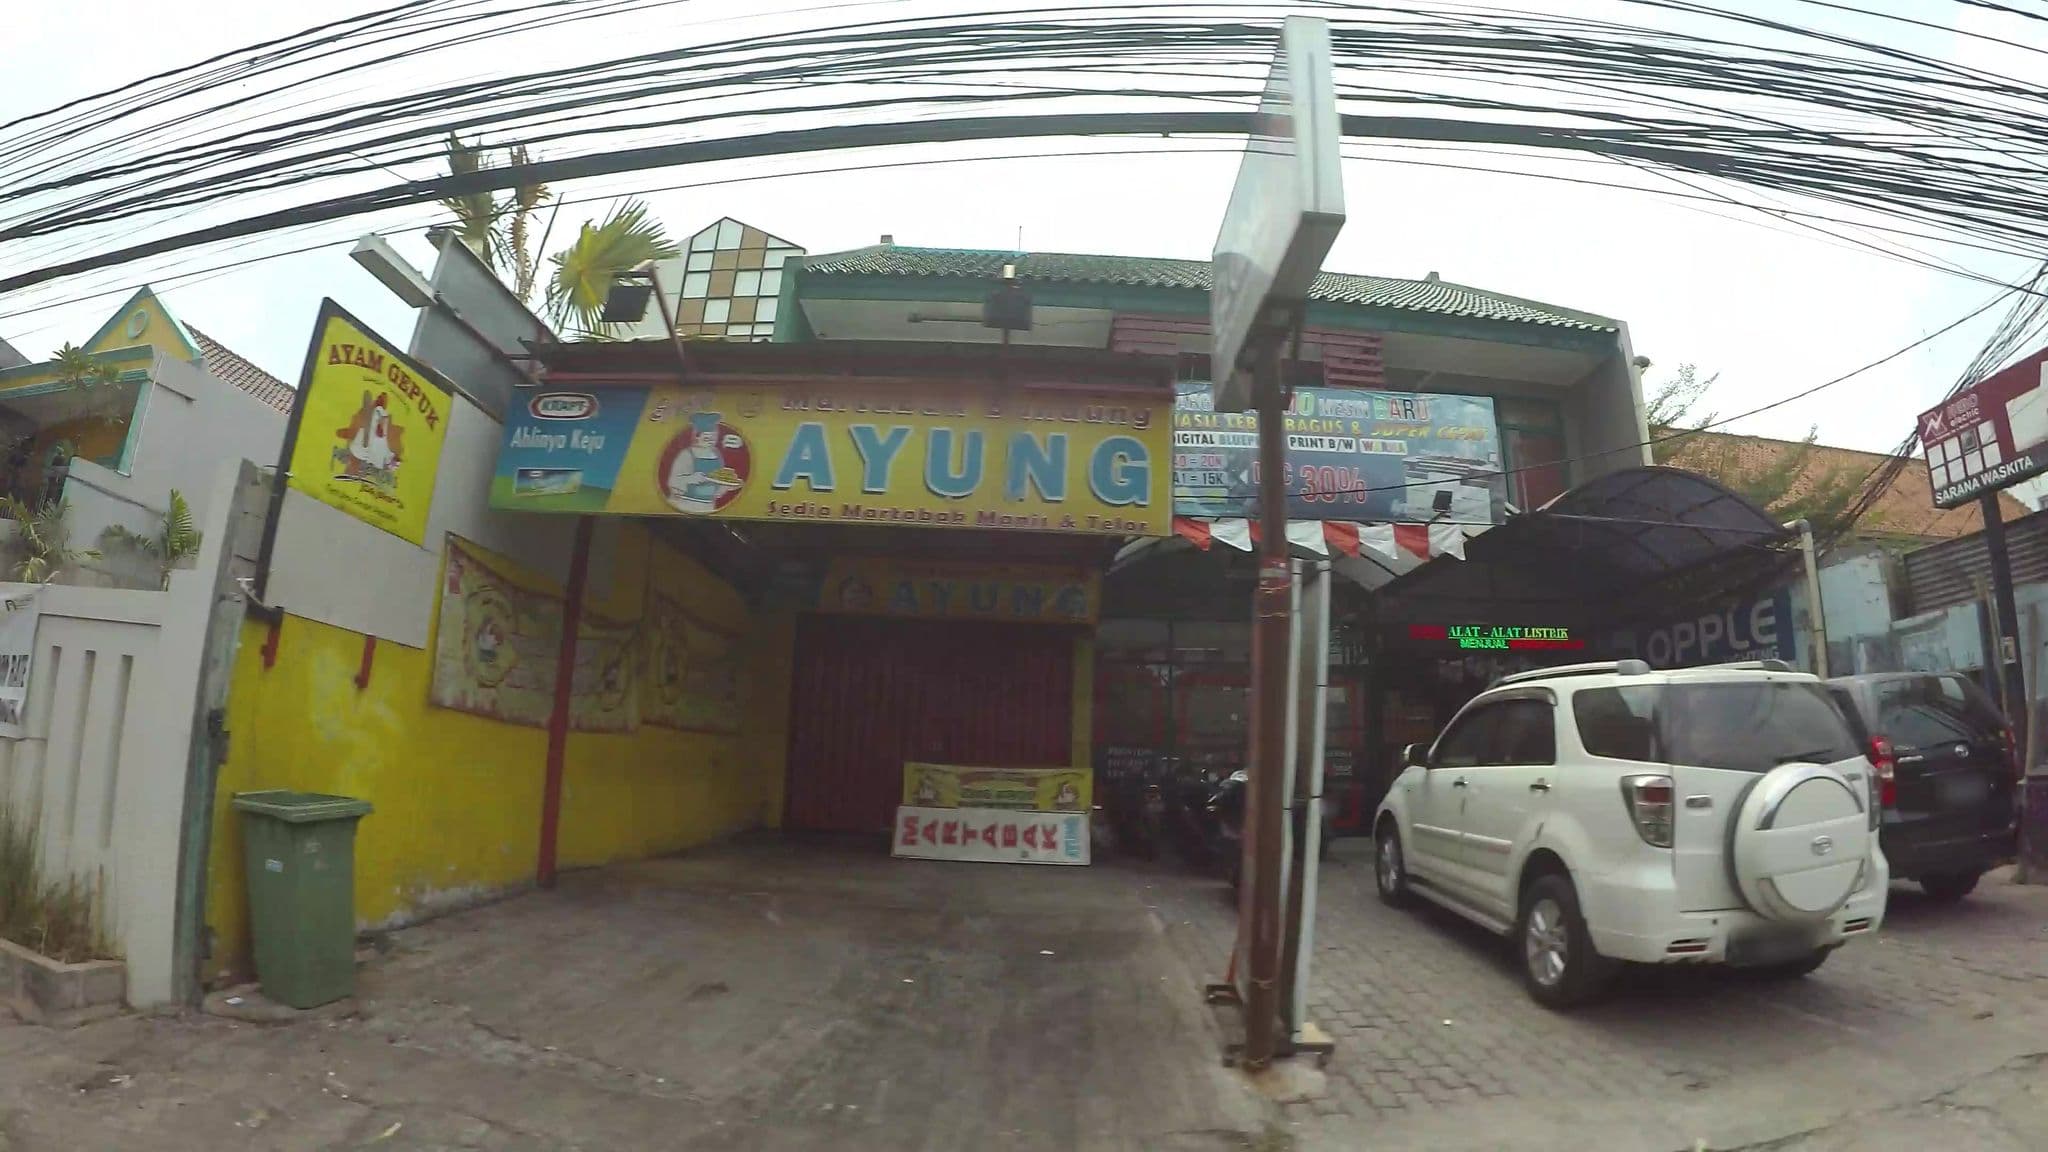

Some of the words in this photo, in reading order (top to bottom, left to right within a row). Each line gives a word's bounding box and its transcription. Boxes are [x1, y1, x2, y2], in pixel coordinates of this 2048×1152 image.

[328, 344, 385, 373] AYAM
[387, 363, 439, 431] GEPUK
[1373, 396, 1432, 421] BARU
[510, 426, 567, 453] Ahlinya
[570, 428, 605, 455] Keju
[1227, 415, 1258, 430] LEB
[1284, 418, 1344, 435] BAGUS
[1351, 421, 1362, 437] &
[1289, 436, 1326, 449] PRINT
[1328, 438, 1354, 452] B/W
[770, 421, 1153, 507] AYUNG
[1203, 472, 1223, 485] 15K
[1301, 464, 1367, 504] 30%
[1935, 478, 1981, 504] SARANA
[1981, 455, 2034, 485] WASKITA
[767, 500, 832, 519] Sedia
[841, 504, 968, 526] Martabak
[1059, 512, 1077, 530] &
[1085, 514, 1151, 532] Telor
[1448, 626, 1481, 637] ALAT
[1491, 627, 1521, 638] ALAT
[1524, 627, 1568, 639] LISTRIK
[1460, 639, 1509, 649] MENJUAL
[1647, 597, 1778, 667] OPPLE
[901, 814, 1059, 851] MARTABAK
